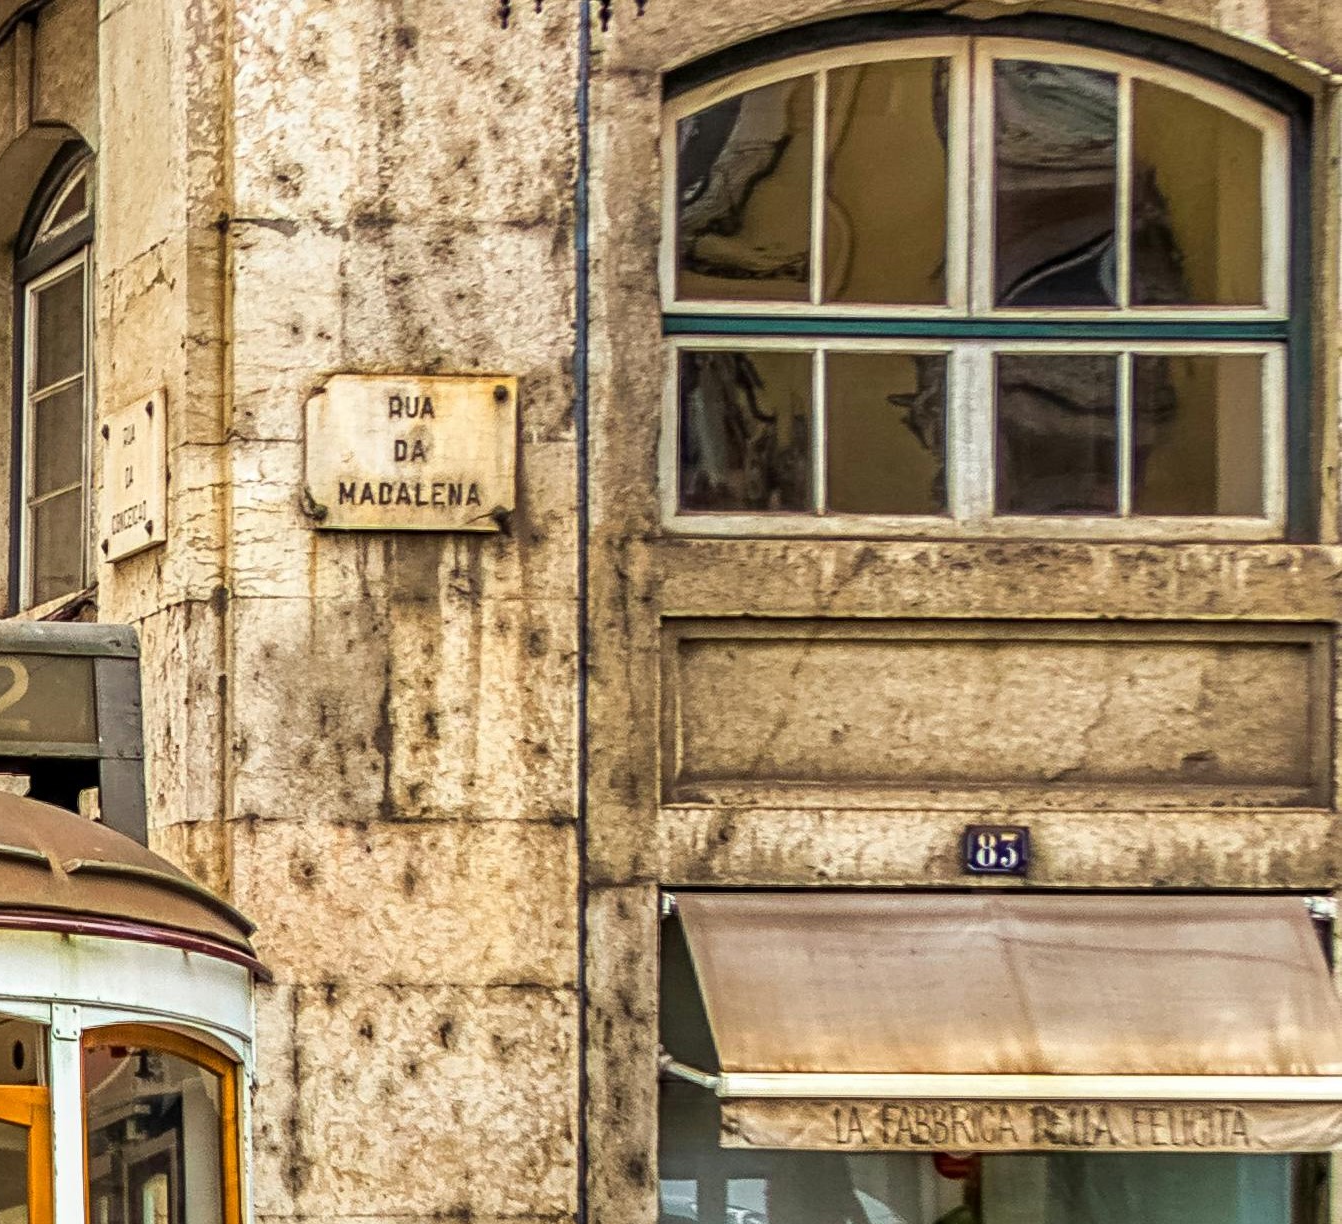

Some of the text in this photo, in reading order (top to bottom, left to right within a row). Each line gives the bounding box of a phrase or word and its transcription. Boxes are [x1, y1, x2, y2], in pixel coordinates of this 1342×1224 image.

[388, 395, 436, 419] RUA
[394, 439, 426, 462] DA
[339, 482, 481, 506] MADALENA
[833, 1105, 867, 1144] LA
[880, 1103, 1020, 1145] FABBRICA
